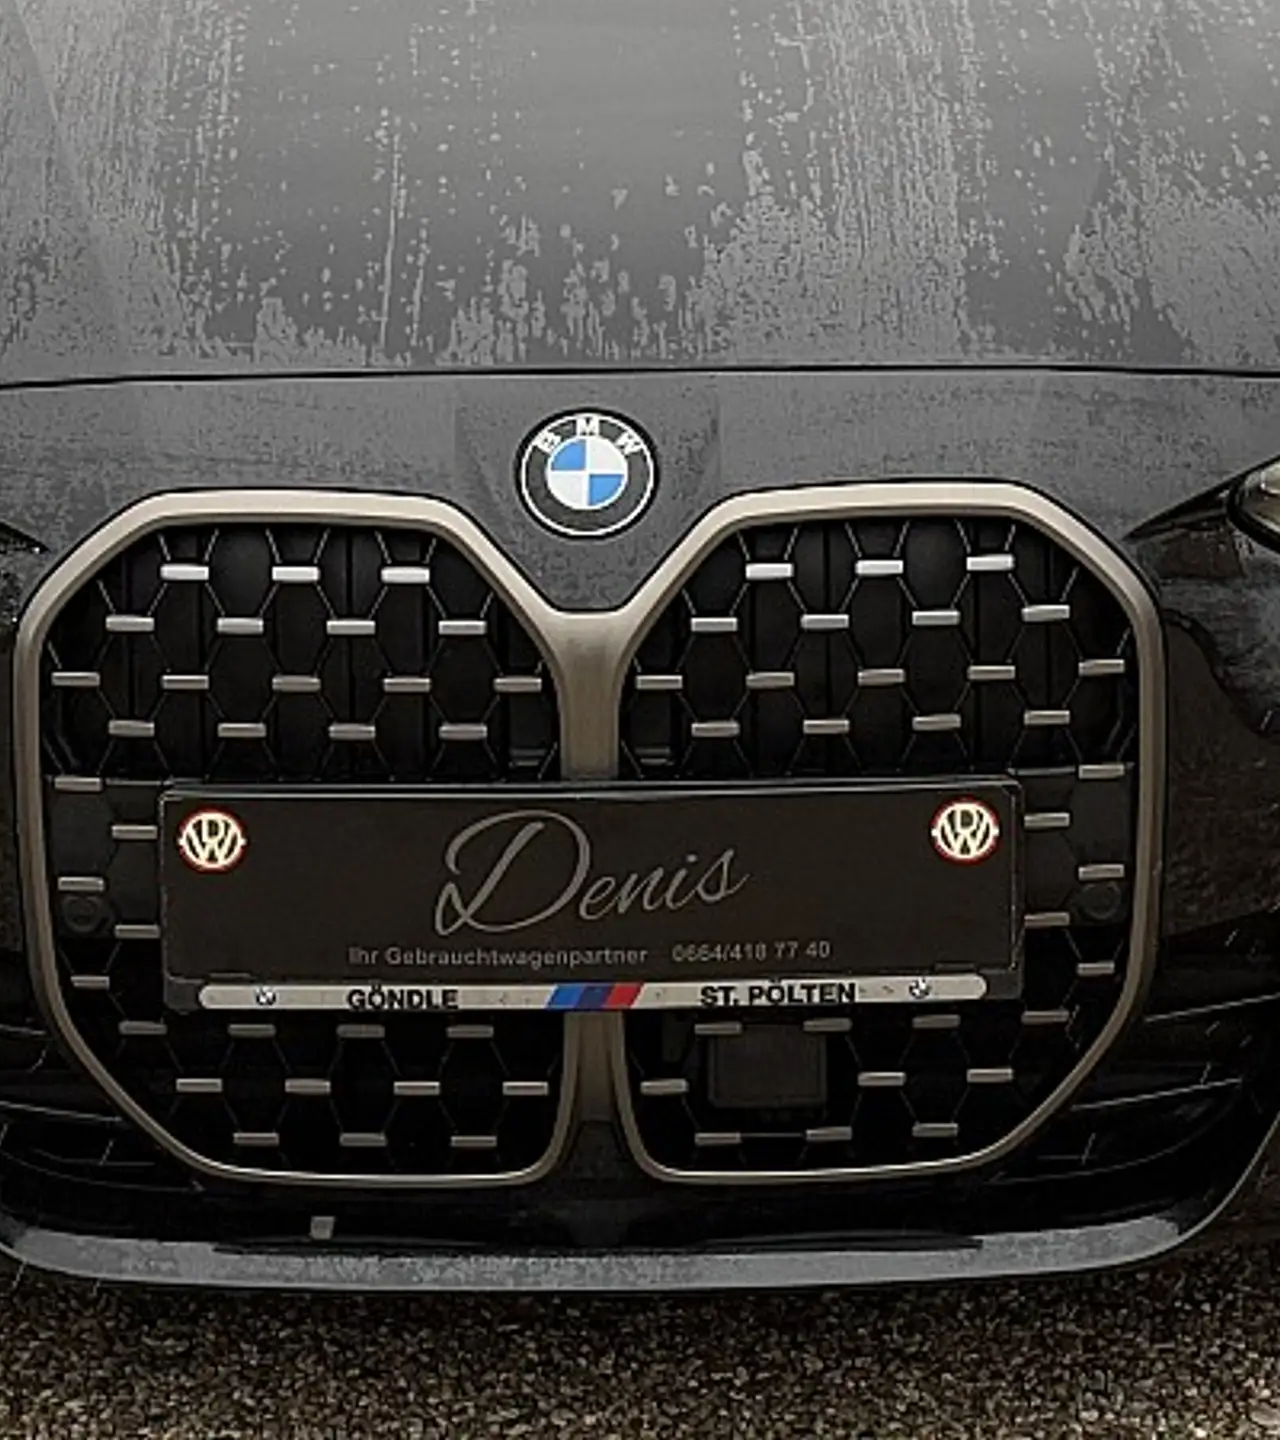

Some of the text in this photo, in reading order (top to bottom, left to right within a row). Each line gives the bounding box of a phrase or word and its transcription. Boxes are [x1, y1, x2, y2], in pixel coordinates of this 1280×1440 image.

[532, 415, 644, 455] BMW
[433, 808, 750, 937] Denis
[348, 946, 380, 965] Ihr
[384, 945, 648, 970] Gebrauchtwagenpartner
[774, 941, 799, 959] 77
[806, 940, 831, 958] 40
[346, 978, 857, 1010] GÖNDLE ST. PÖLTEN
